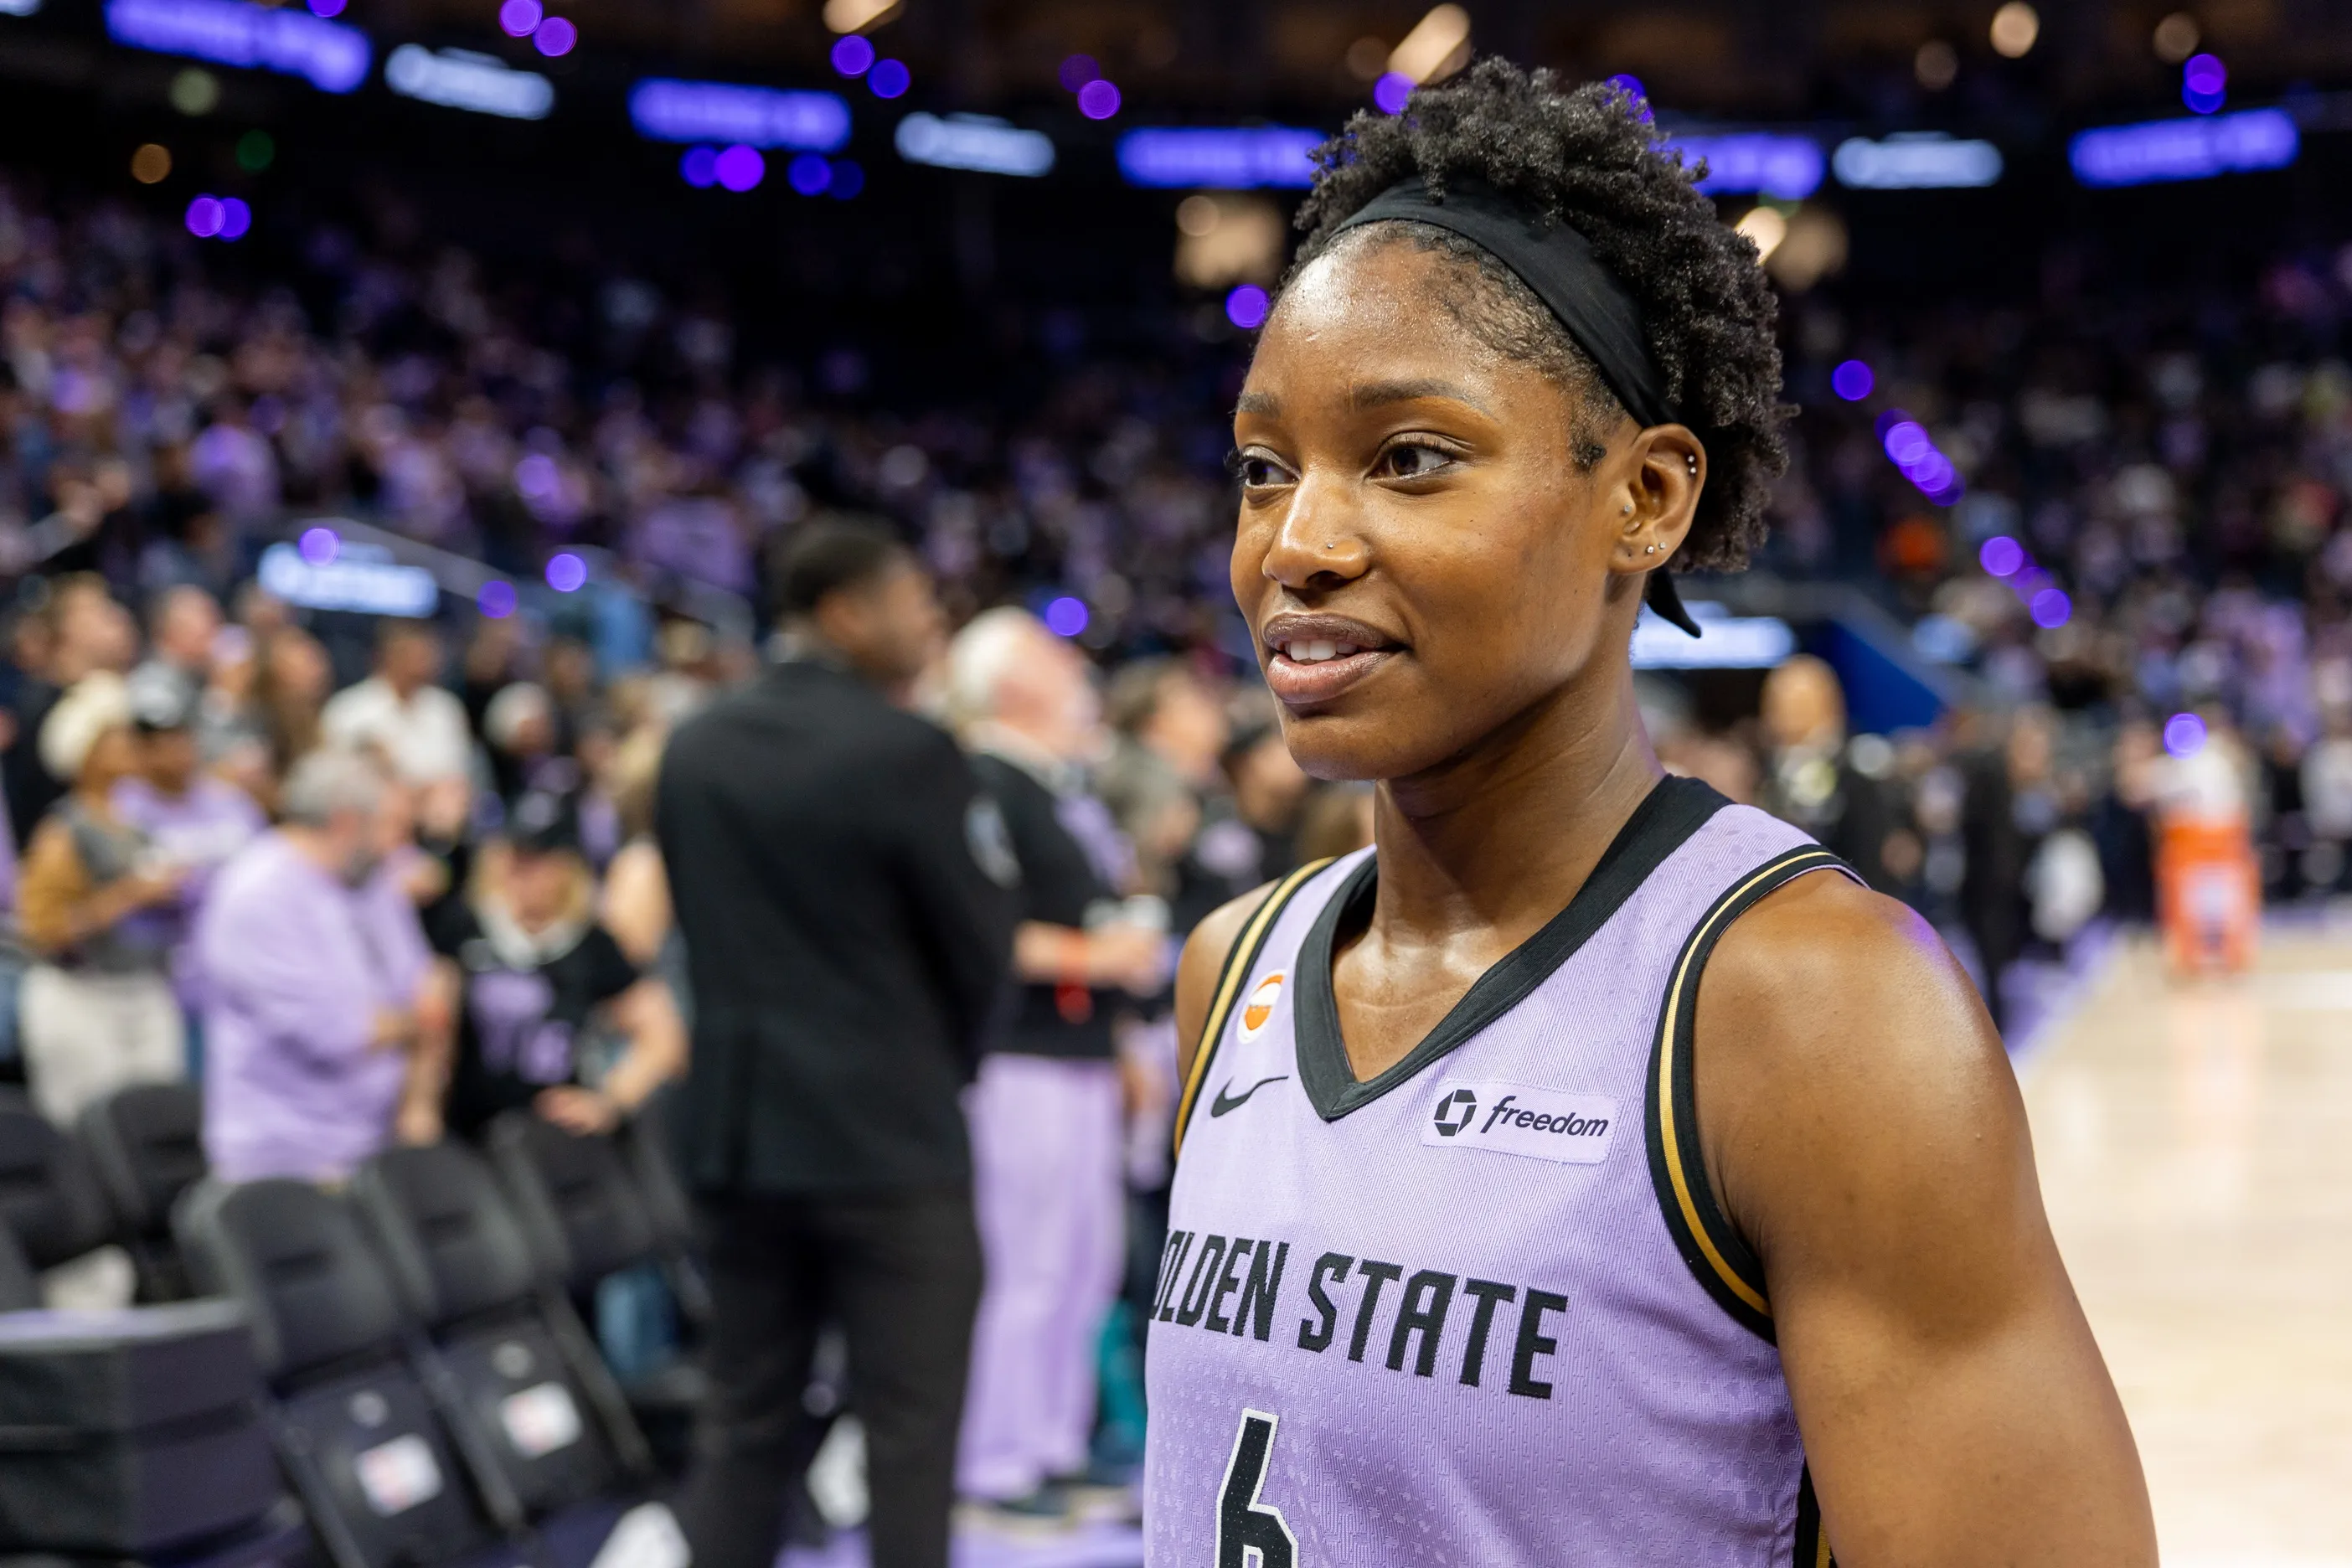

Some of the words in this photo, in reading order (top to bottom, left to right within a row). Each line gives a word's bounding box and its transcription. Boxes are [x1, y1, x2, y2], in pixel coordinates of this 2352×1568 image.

[1480, 1095, 1609, 1137] freedom
[1149, 1230, 1290, 1342] OLDEN
[1297, 1251, 1569, 1400] STATE
